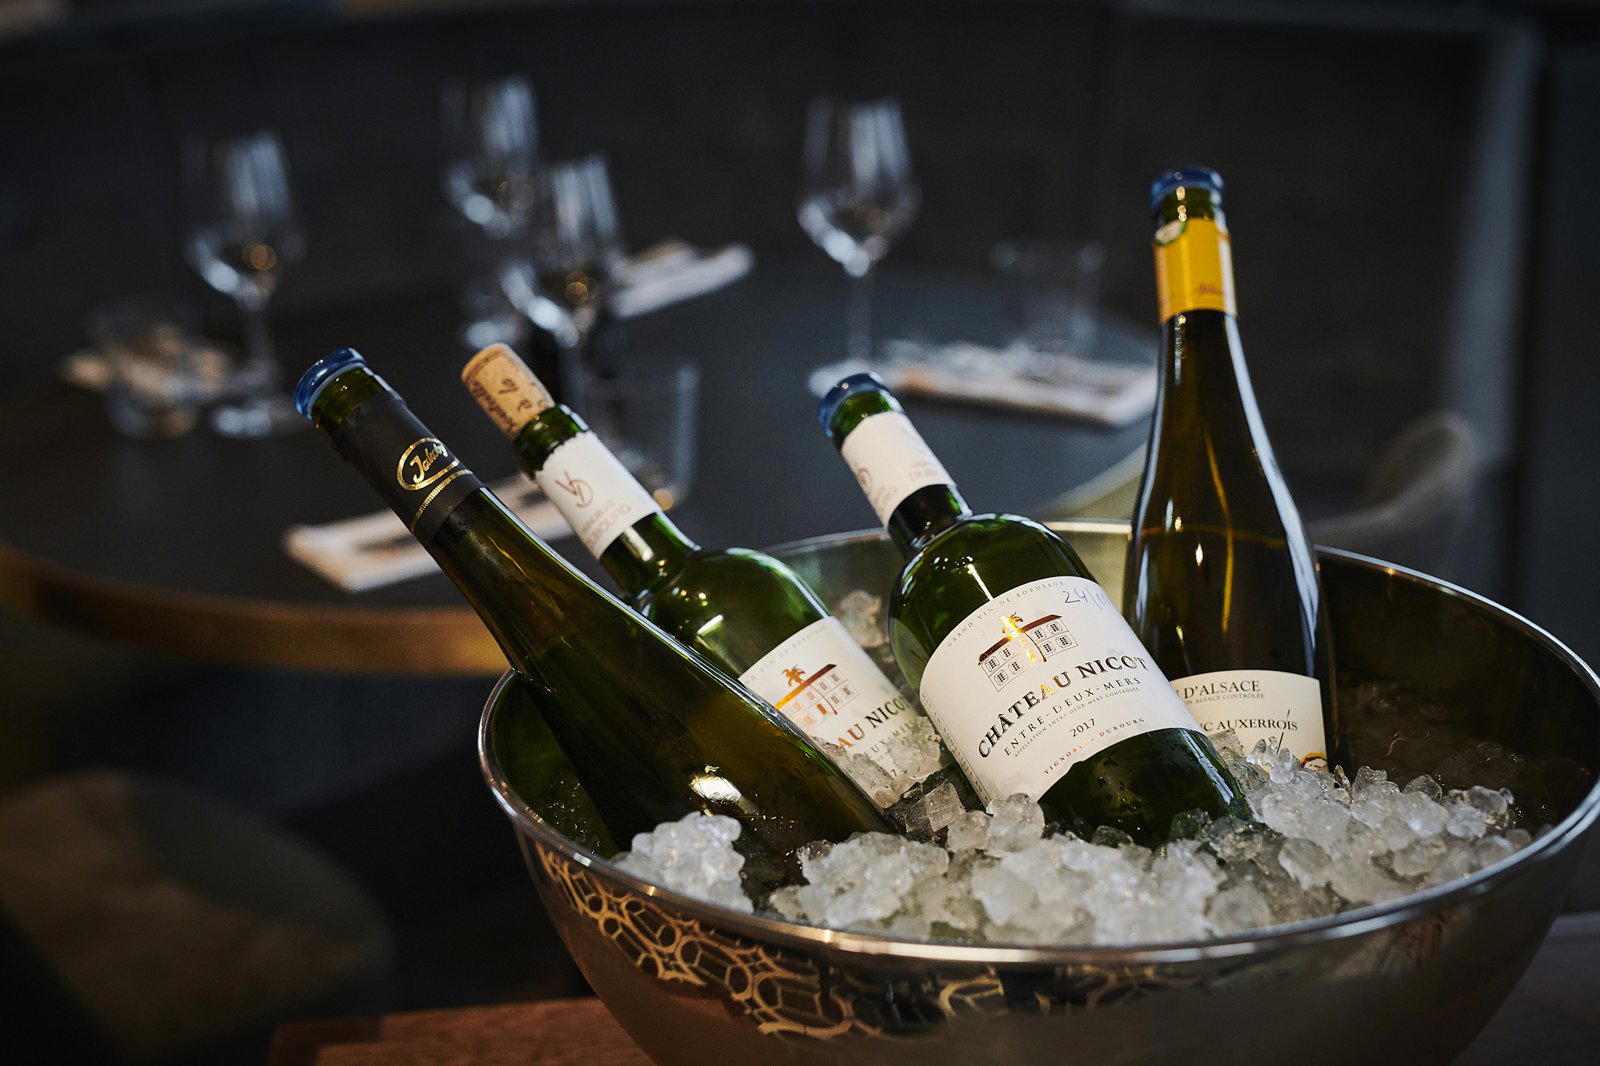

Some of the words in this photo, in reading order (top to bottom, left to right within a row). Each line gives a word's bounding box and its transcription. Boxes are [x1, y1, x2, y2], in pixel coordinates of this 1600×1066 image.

[947, 621, 974, 647] GRAND
[976, 607, 994, 620] VIN
[999, 597, 1011, 607] DE
[1184, 680, 1261, 699] D'ALSACE
[978, 671, 1071, 758] CHÂTEAU
[1075, 655, 1149, 679] NICOT
[1069, 718, 1096, 738] 2017
[1099, 716, 1145, 737] DUBOURG
[1216, 718, 1299, 732] AUXERROIS
